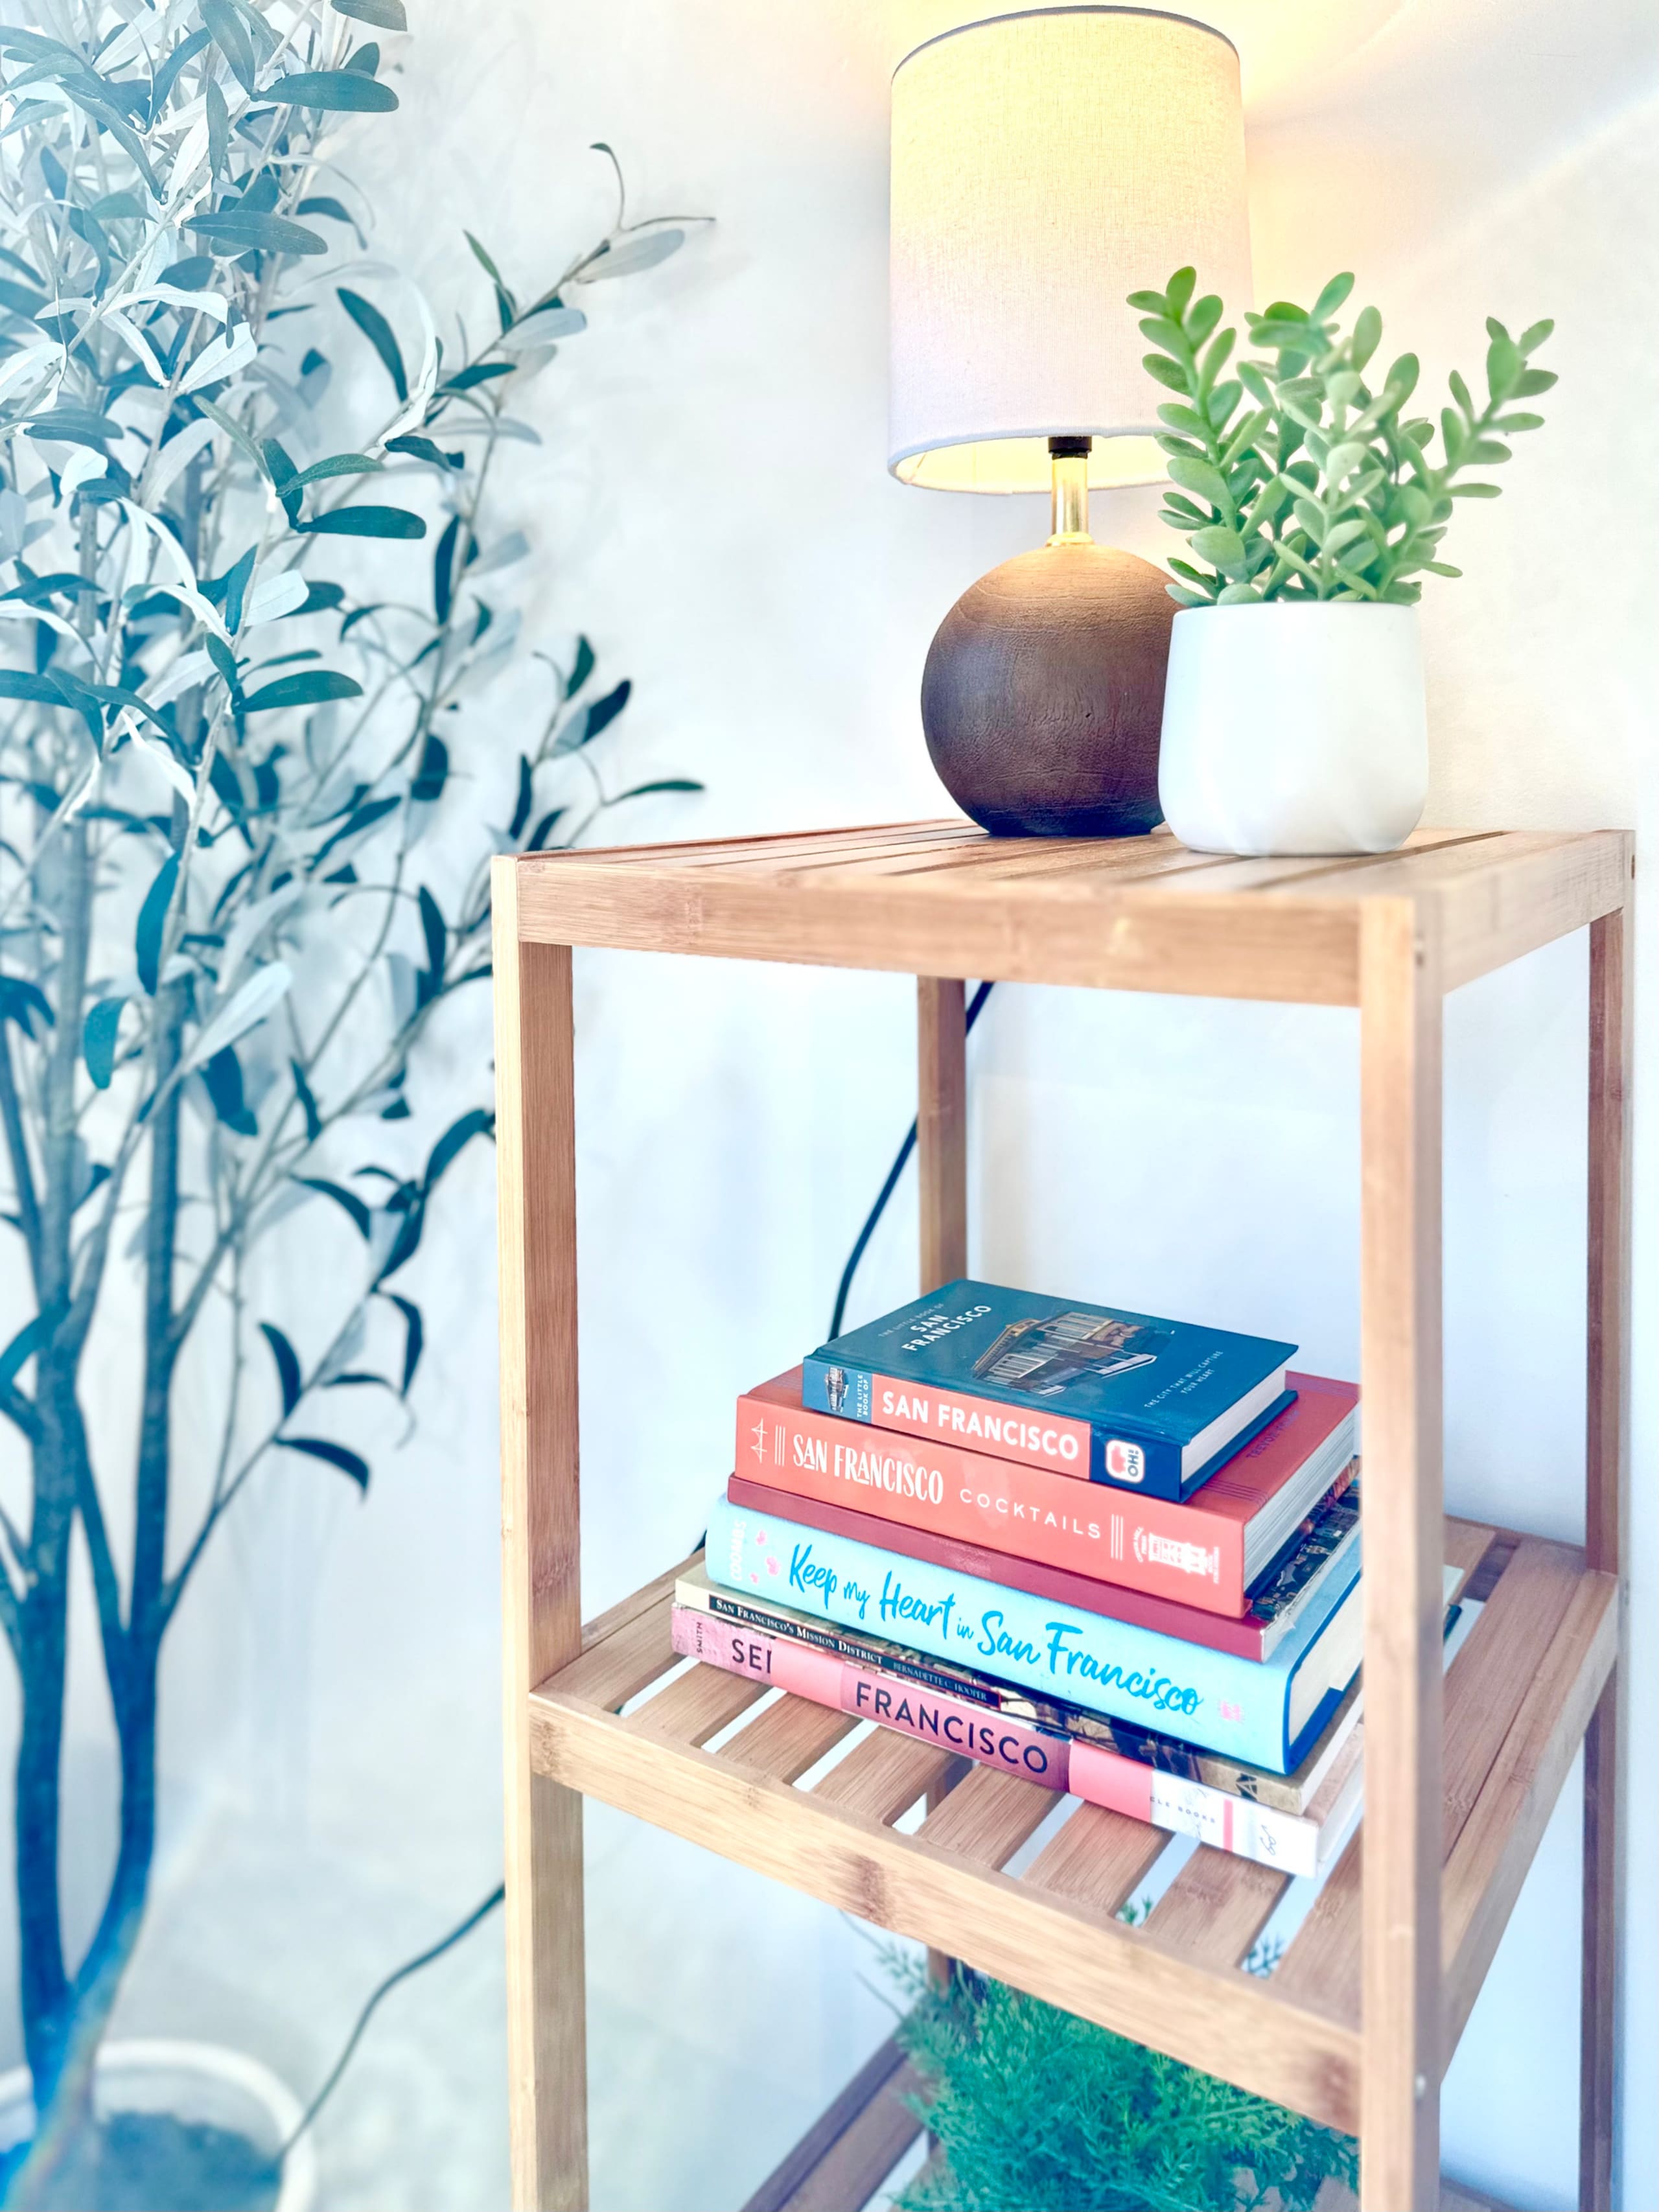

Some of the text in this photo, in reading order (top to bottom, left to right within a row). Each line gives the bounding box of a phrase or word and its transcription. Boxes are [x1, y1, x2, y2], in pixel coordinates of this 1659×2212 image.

[901, 1305, 992, 1351] FRANCISCO
[911, 1314, 949, 1333] SAN
[863, 1379, 868, 1390] OF
[1157, 1389, 1172, 1399] CITY
[1170, 1378, 1187, 1388] THAT
[1185, 1368, 1201, 1378] WILL
[1198, 1351, 1224, 1368] CAPTURE
[1180, 1369, 1215, 1393] YOUR HEART
[882, 1391, 1079, 1460] SAN FRANCISCO
[793, 1434, 944, 1504] SAN FRANCISCO
[960, 1488, 1101, 1539] COCKTAILS
[730, 1519, 747, 1581] COOMBS
[789, 1544, 1204, 1715] Keep my Heart in San Francisco
[856, 1681, 1048, 1774] FRANCISCO
[1178, 1806, 1216, 1823] BOOKS
